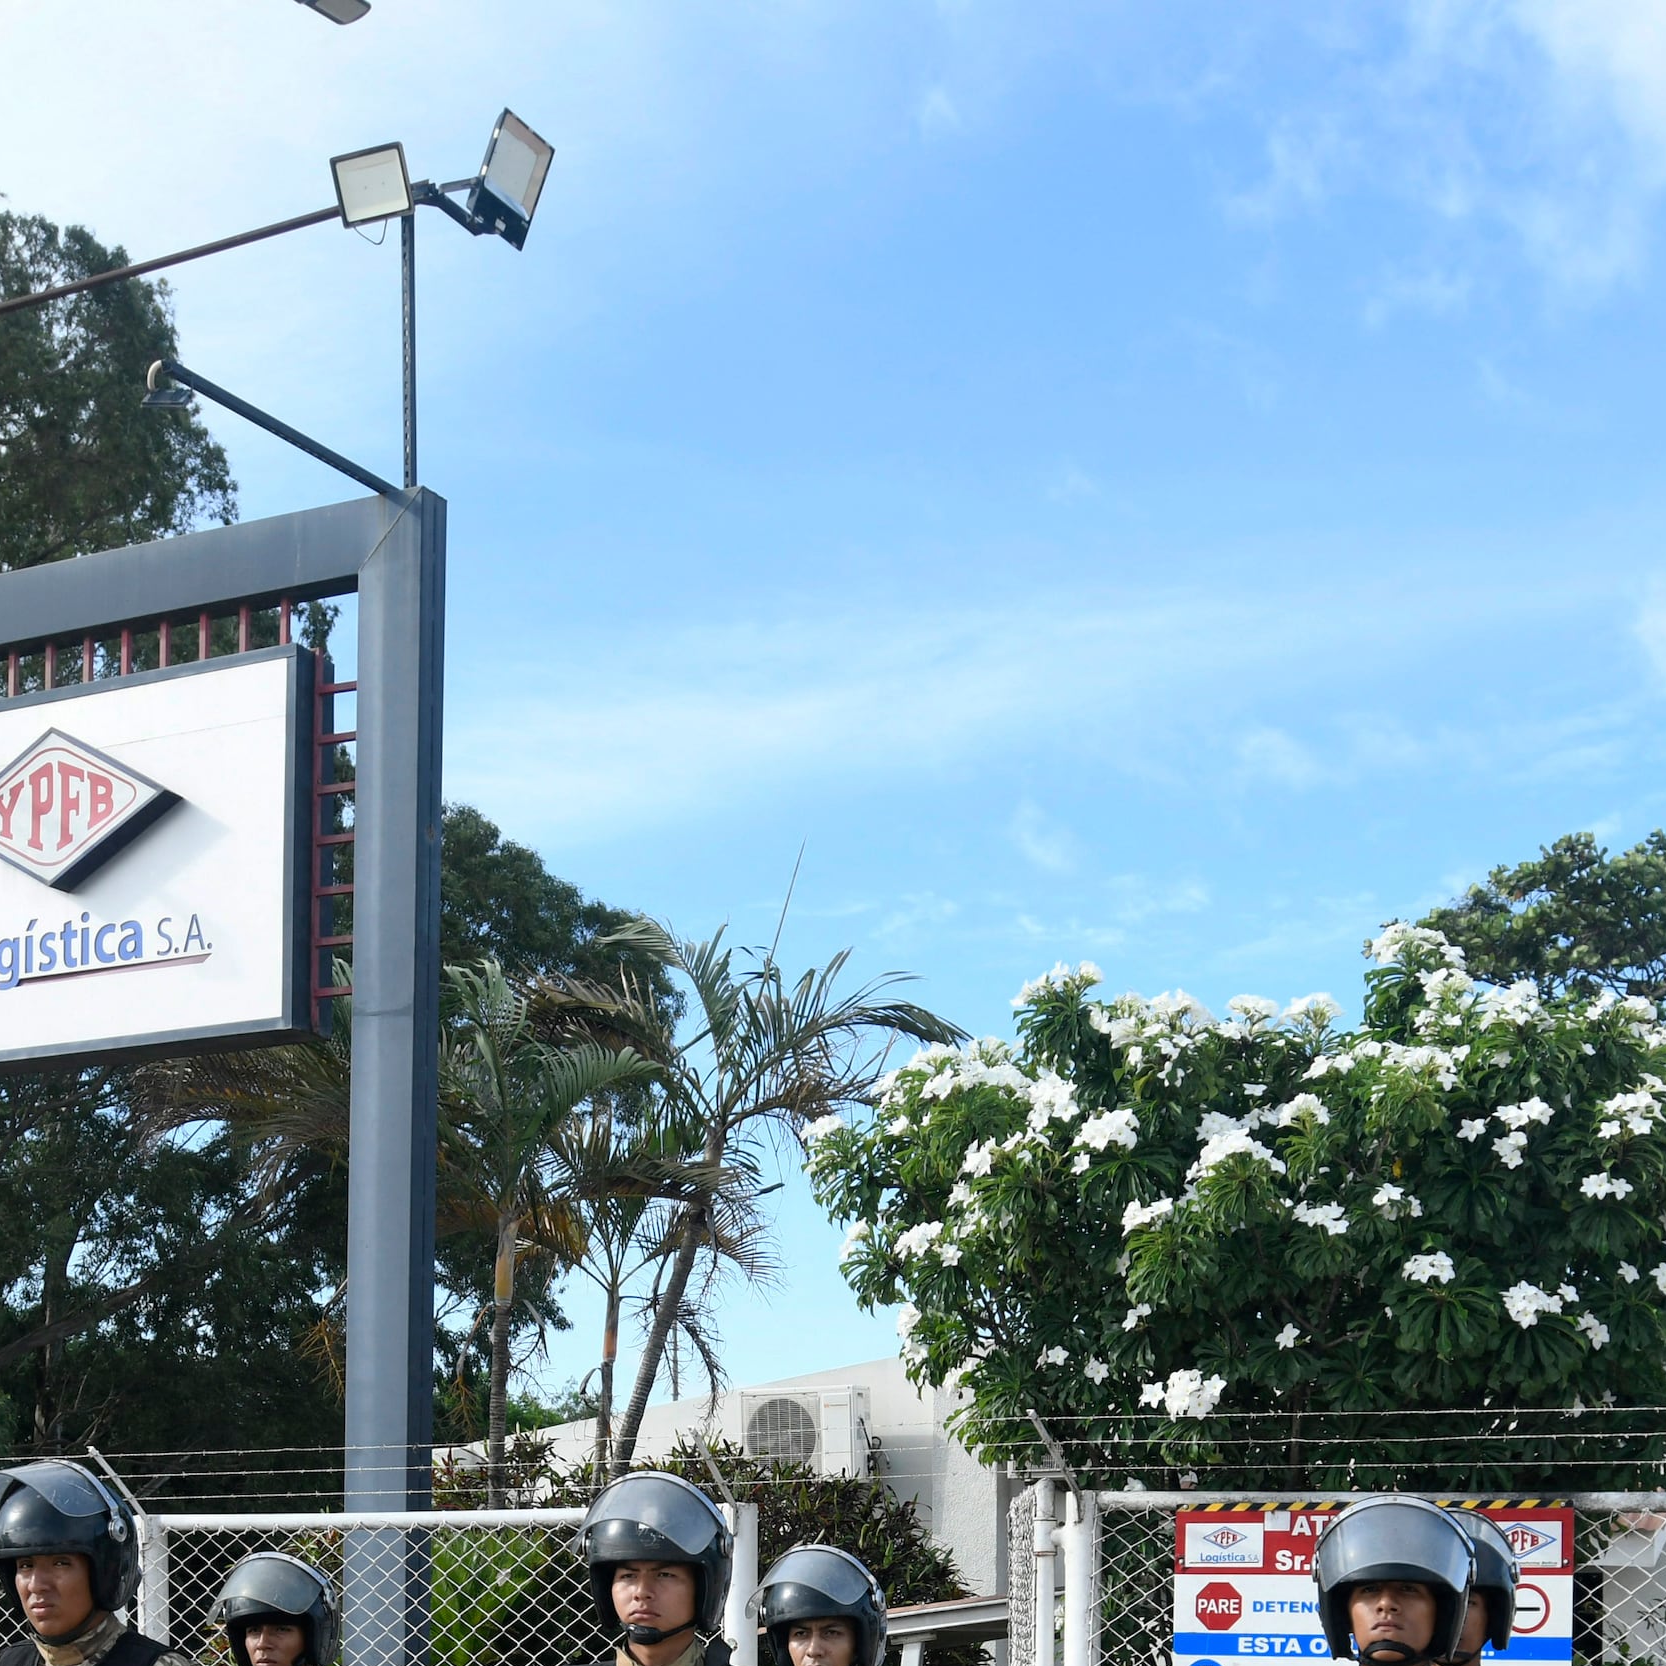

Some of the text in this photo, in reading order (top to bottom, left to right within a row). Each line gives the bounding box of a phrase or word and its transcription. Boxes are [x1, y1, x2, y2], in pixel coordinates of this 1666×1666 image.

[157, 913, 213, 956] S.A.
[1506, 1529, 1540, 1552] PFB
[1200, 1552, 1246, 1564] Logística
[1197, 1598, 1240, 1615] PARE
[1238, 1637, 1302, 1654] ESTA
